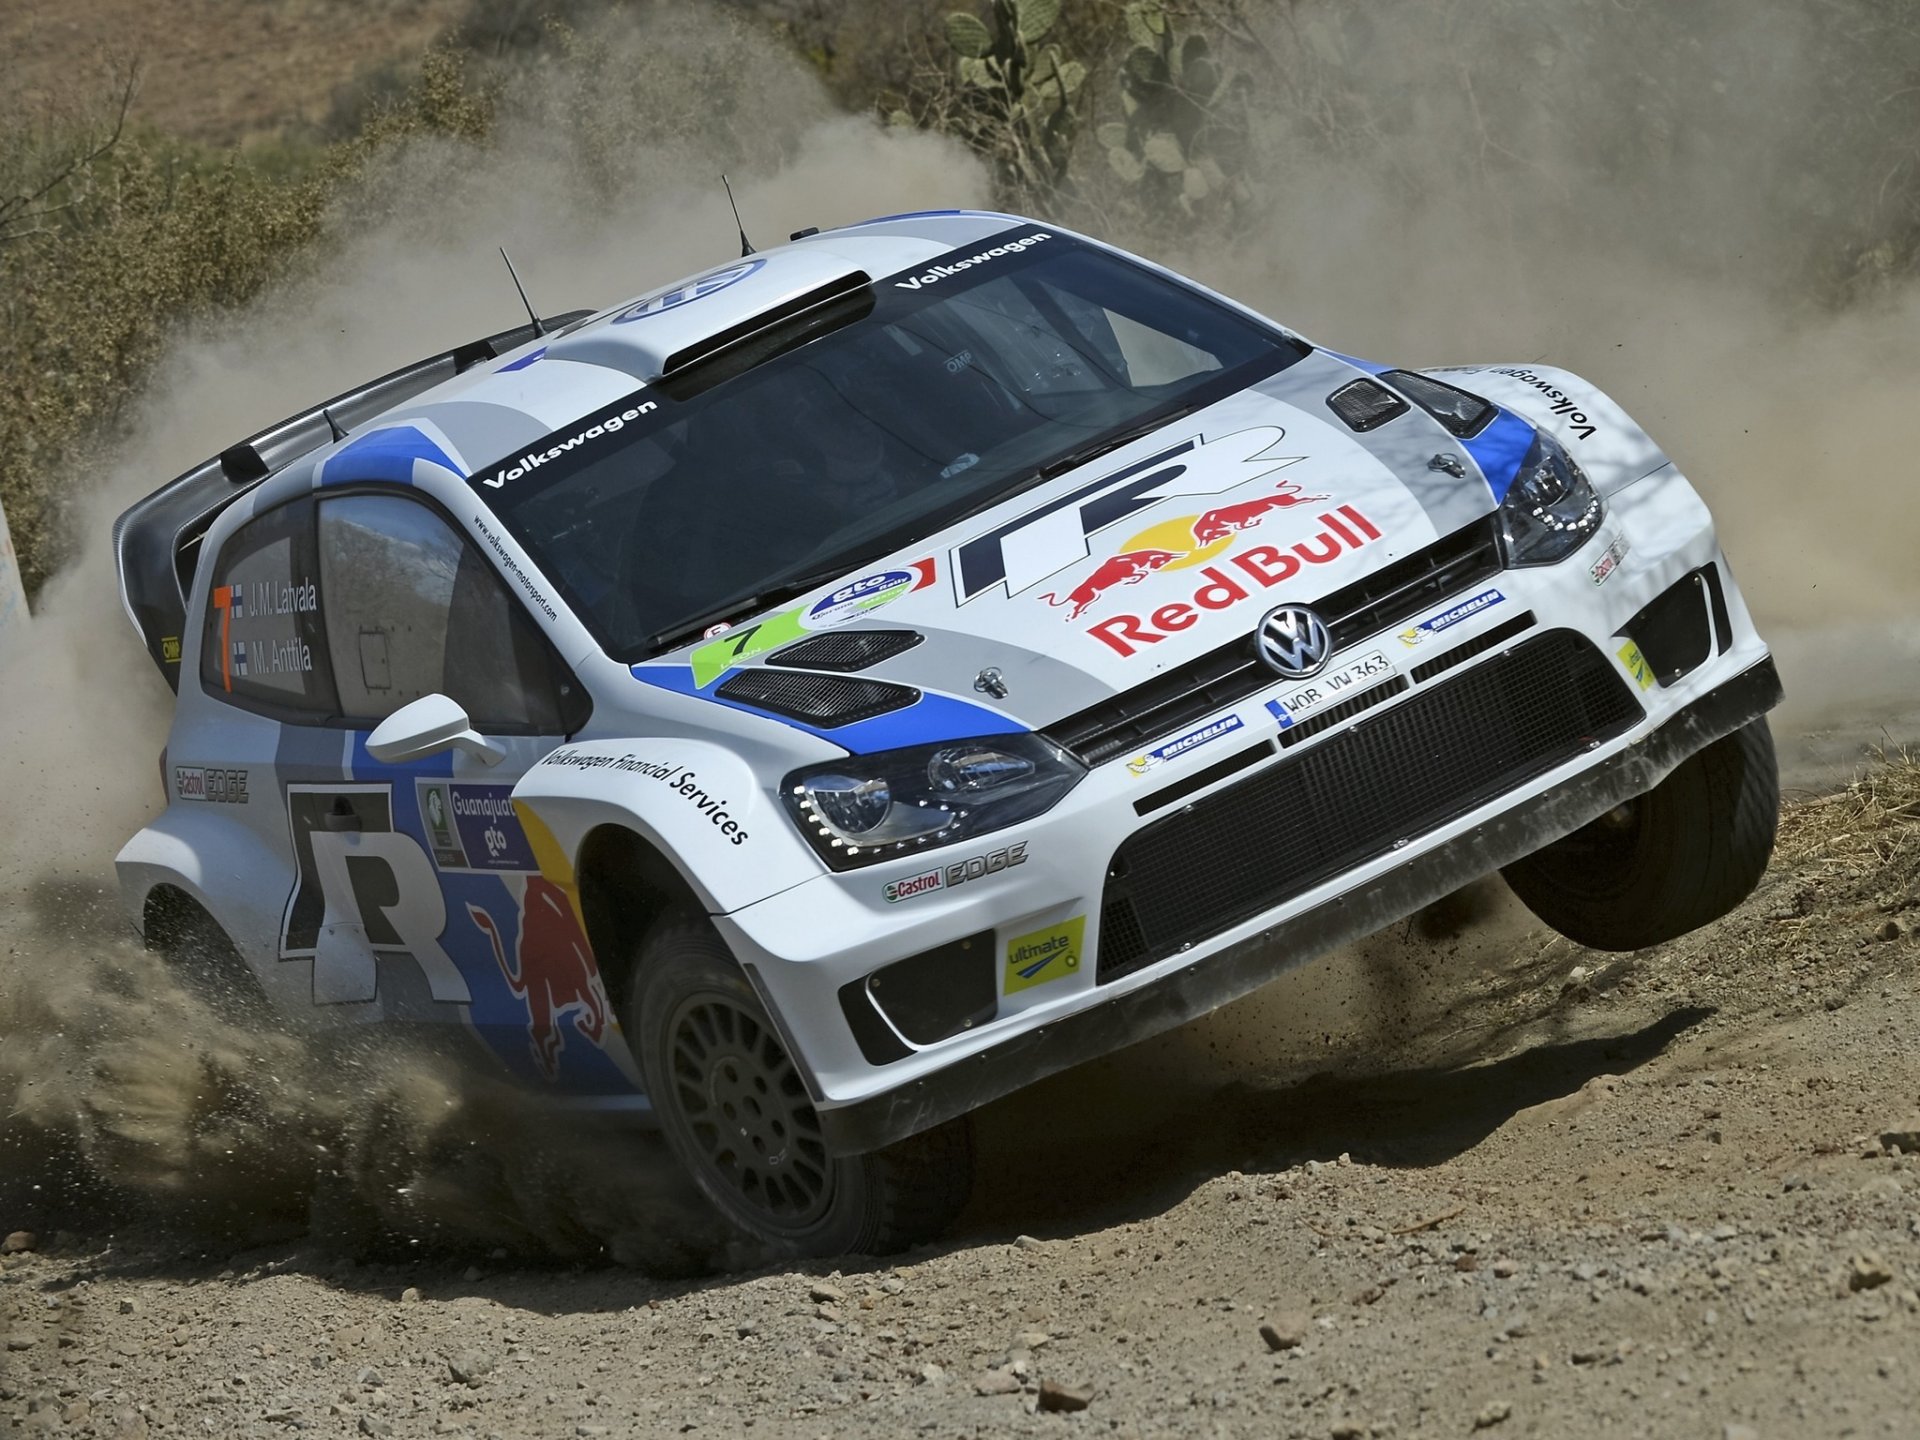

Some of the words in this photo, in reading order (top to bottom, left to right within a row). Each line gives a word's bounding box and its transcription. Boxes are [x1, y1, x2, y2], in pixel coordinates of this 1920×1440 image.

[894, 232, 1052, 290] Volkswagen
[946, 351, 972, 373] OMP
[1489, 367, 1597, 440] Volkswagen
[482, 400, 658, 489] Volkswagen
[473, 515, 558, 622] www.volkswagen-motorsport.com
[1085, 566, 1250, 658] Red
[1231, 504, 1382, 588] Bull
[275, 576, 317, 614] Latvala
[832, 575, 886, 603] gto
[1431, 590, 1500, 630] MICHELIN
[253, 640, 270, 674] M.
[272, 636, 313, 673] Anttila
[724, 624, 762, 656] 7
[1326, 671, 1352, 691] VW
[1351, 655, 1389, 680] 363
[1162, 716, 1240, 757] MICHELIN
[205, 768, 249, 803] EDGE
[541, 750, 615, 770] Volkswagen
[609, 754, 684, 781] Financial
[669, 772, 749, 846] Services
[452, 791, 516, 824] Guanajuat
[484, 826, 507, 857] gto
[897, 871, 941, 897] Castrol
[946, 840, 1030, 888] EDGE
[1009, 934, 1070, 964] ultimate
